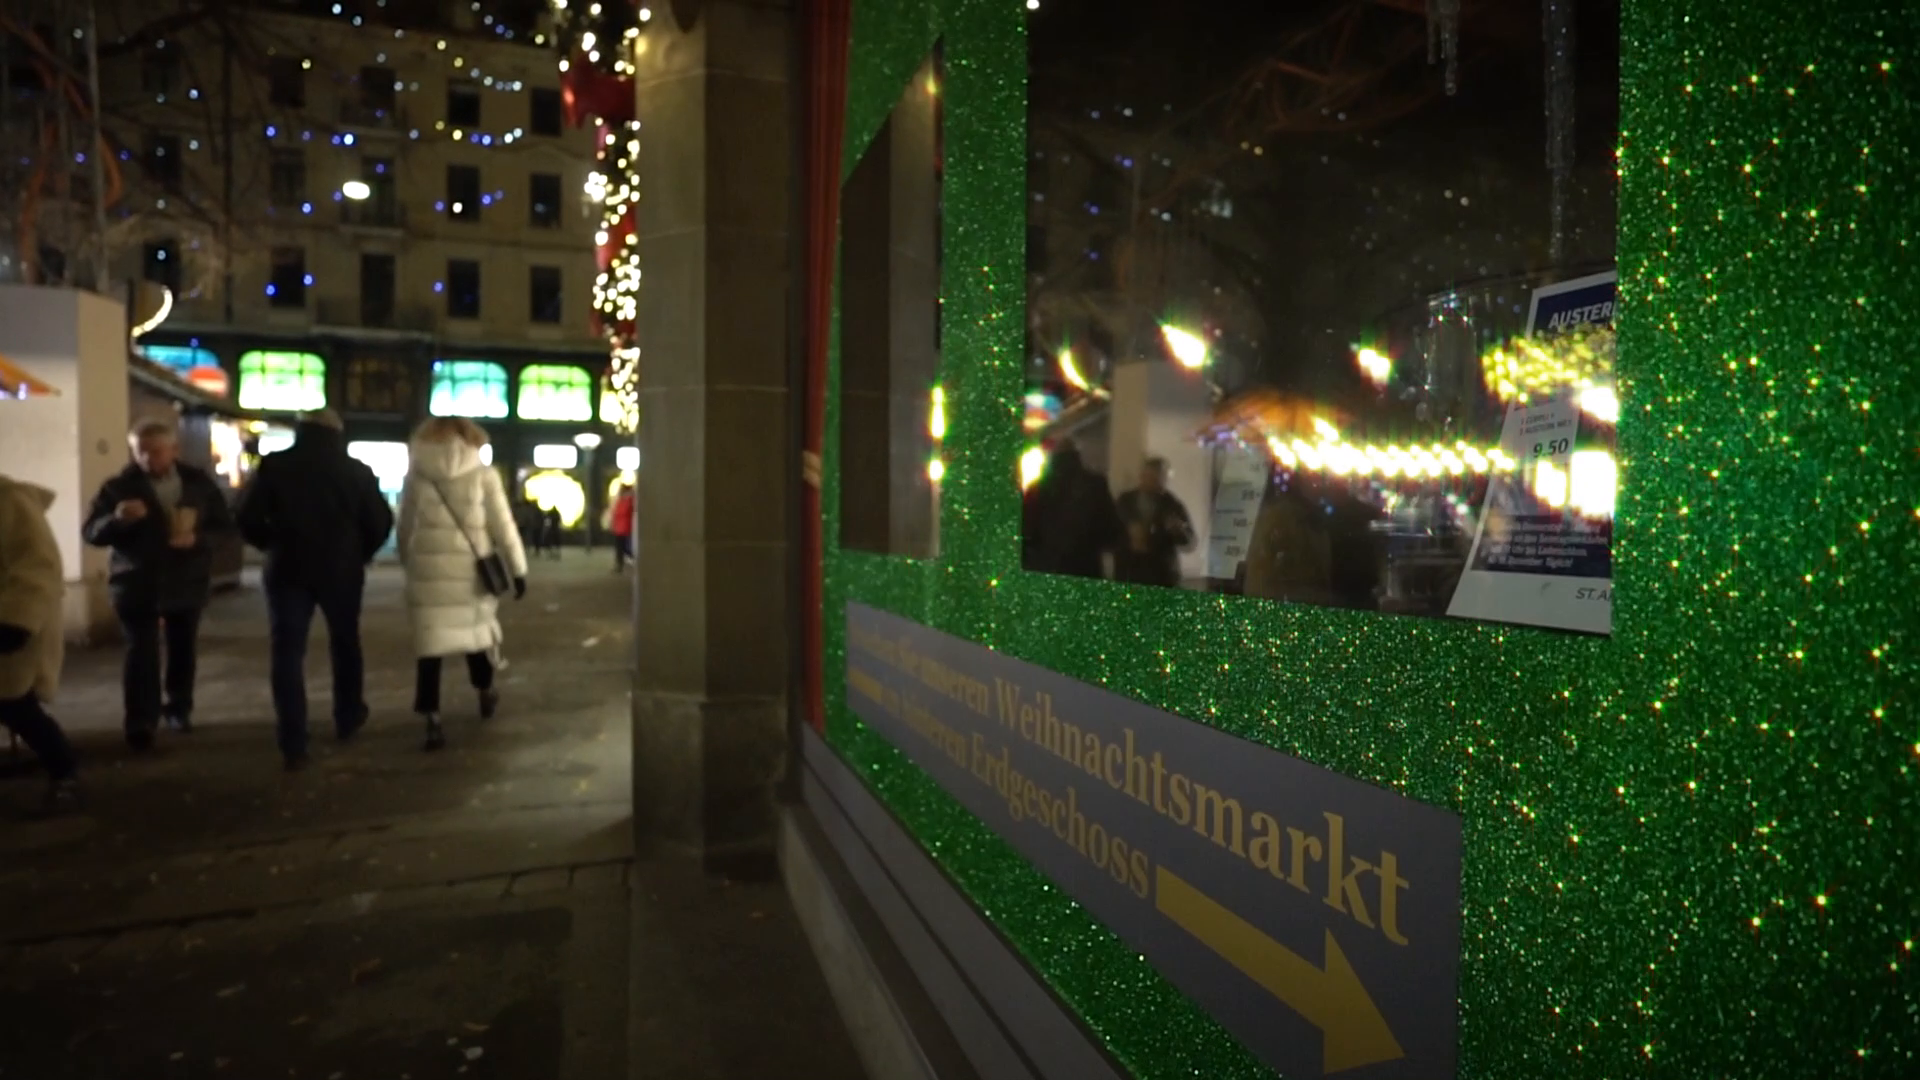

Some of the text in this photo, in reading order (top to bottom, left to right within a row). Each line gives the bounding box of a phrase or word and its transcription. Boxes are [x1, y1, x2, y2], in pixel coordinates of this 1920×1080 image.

[1548, 300, 1616, 330] AUSTER
[1533, 437, 1569, 458] 9.50
[921, 655, 990, 719] unseren
[995, 676, 1410, 947] Weihnachtsmarkt
[971, 732, 1150, 899] Erdgeschoss
